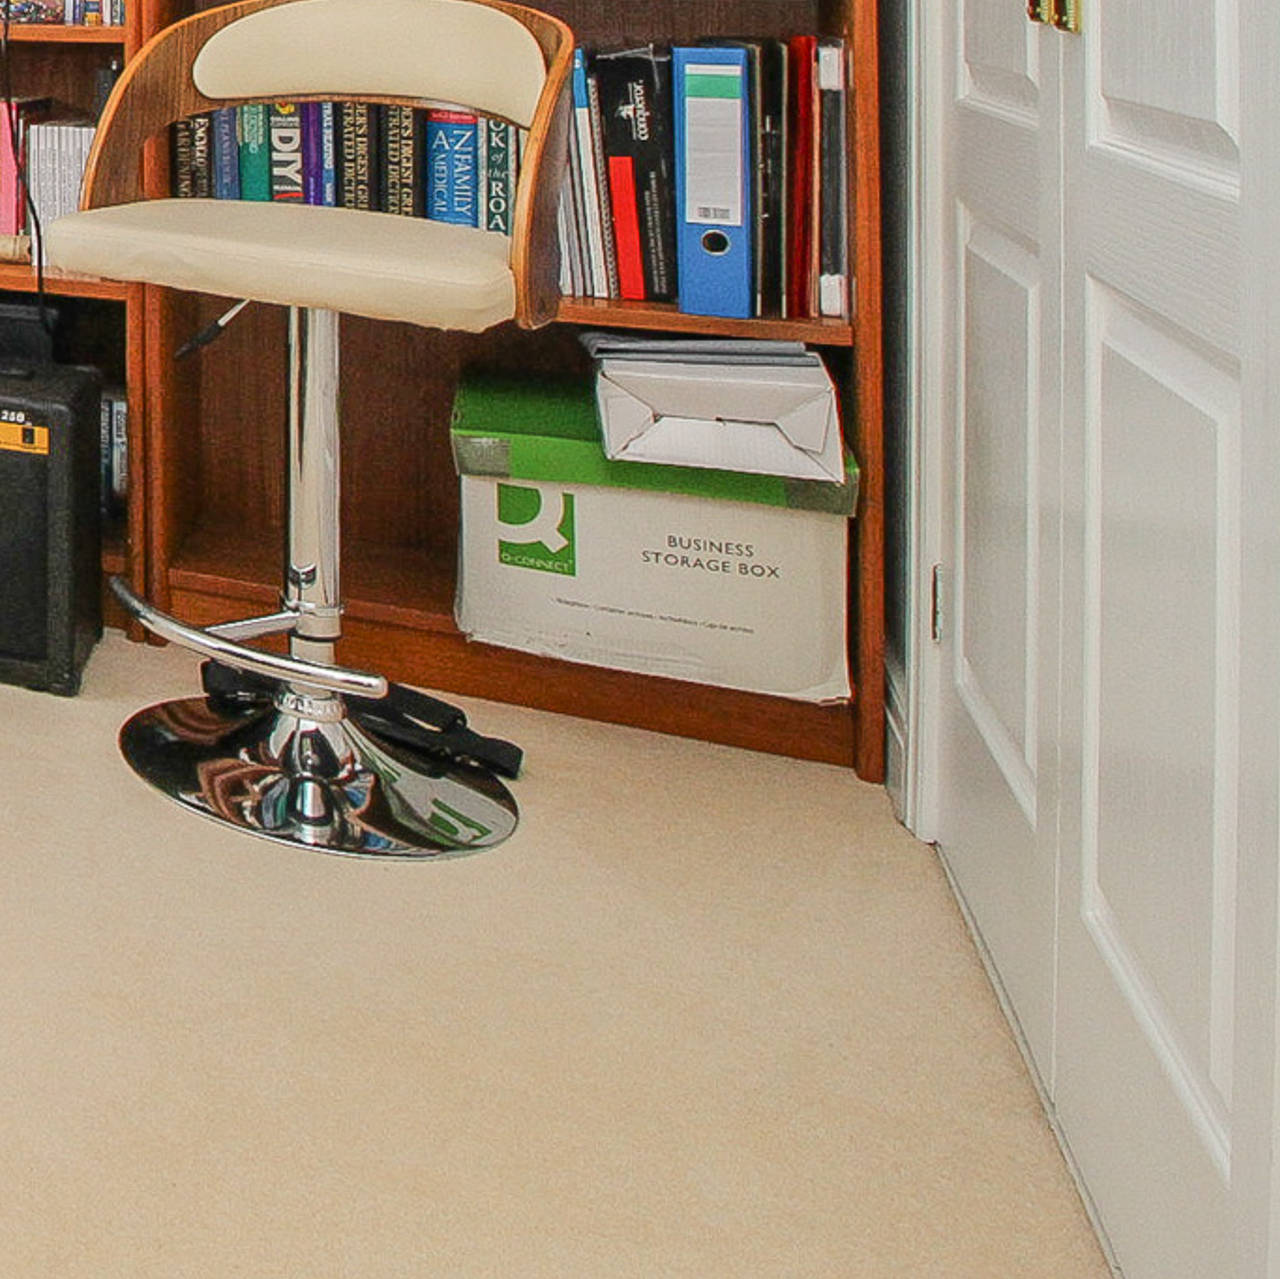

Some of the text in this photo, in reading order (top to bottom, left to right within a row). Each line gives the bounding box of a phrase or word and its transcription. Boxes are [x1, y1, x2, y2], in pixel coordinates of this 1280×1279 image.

[270, 127, 302, 185] DIY
[356, 137, 369, 183] DIGEST
[401, 139, 413, 185] DIGEST
[433, 151, 448, 212] MEDICAL
[453, 151, 473, 216] FAMILY
[500, 552, 570, 572] Q-CONNECT
[641, 550, 781, 579] STORAGE BOX
[666, 534, 755, 558] BUSINESS
